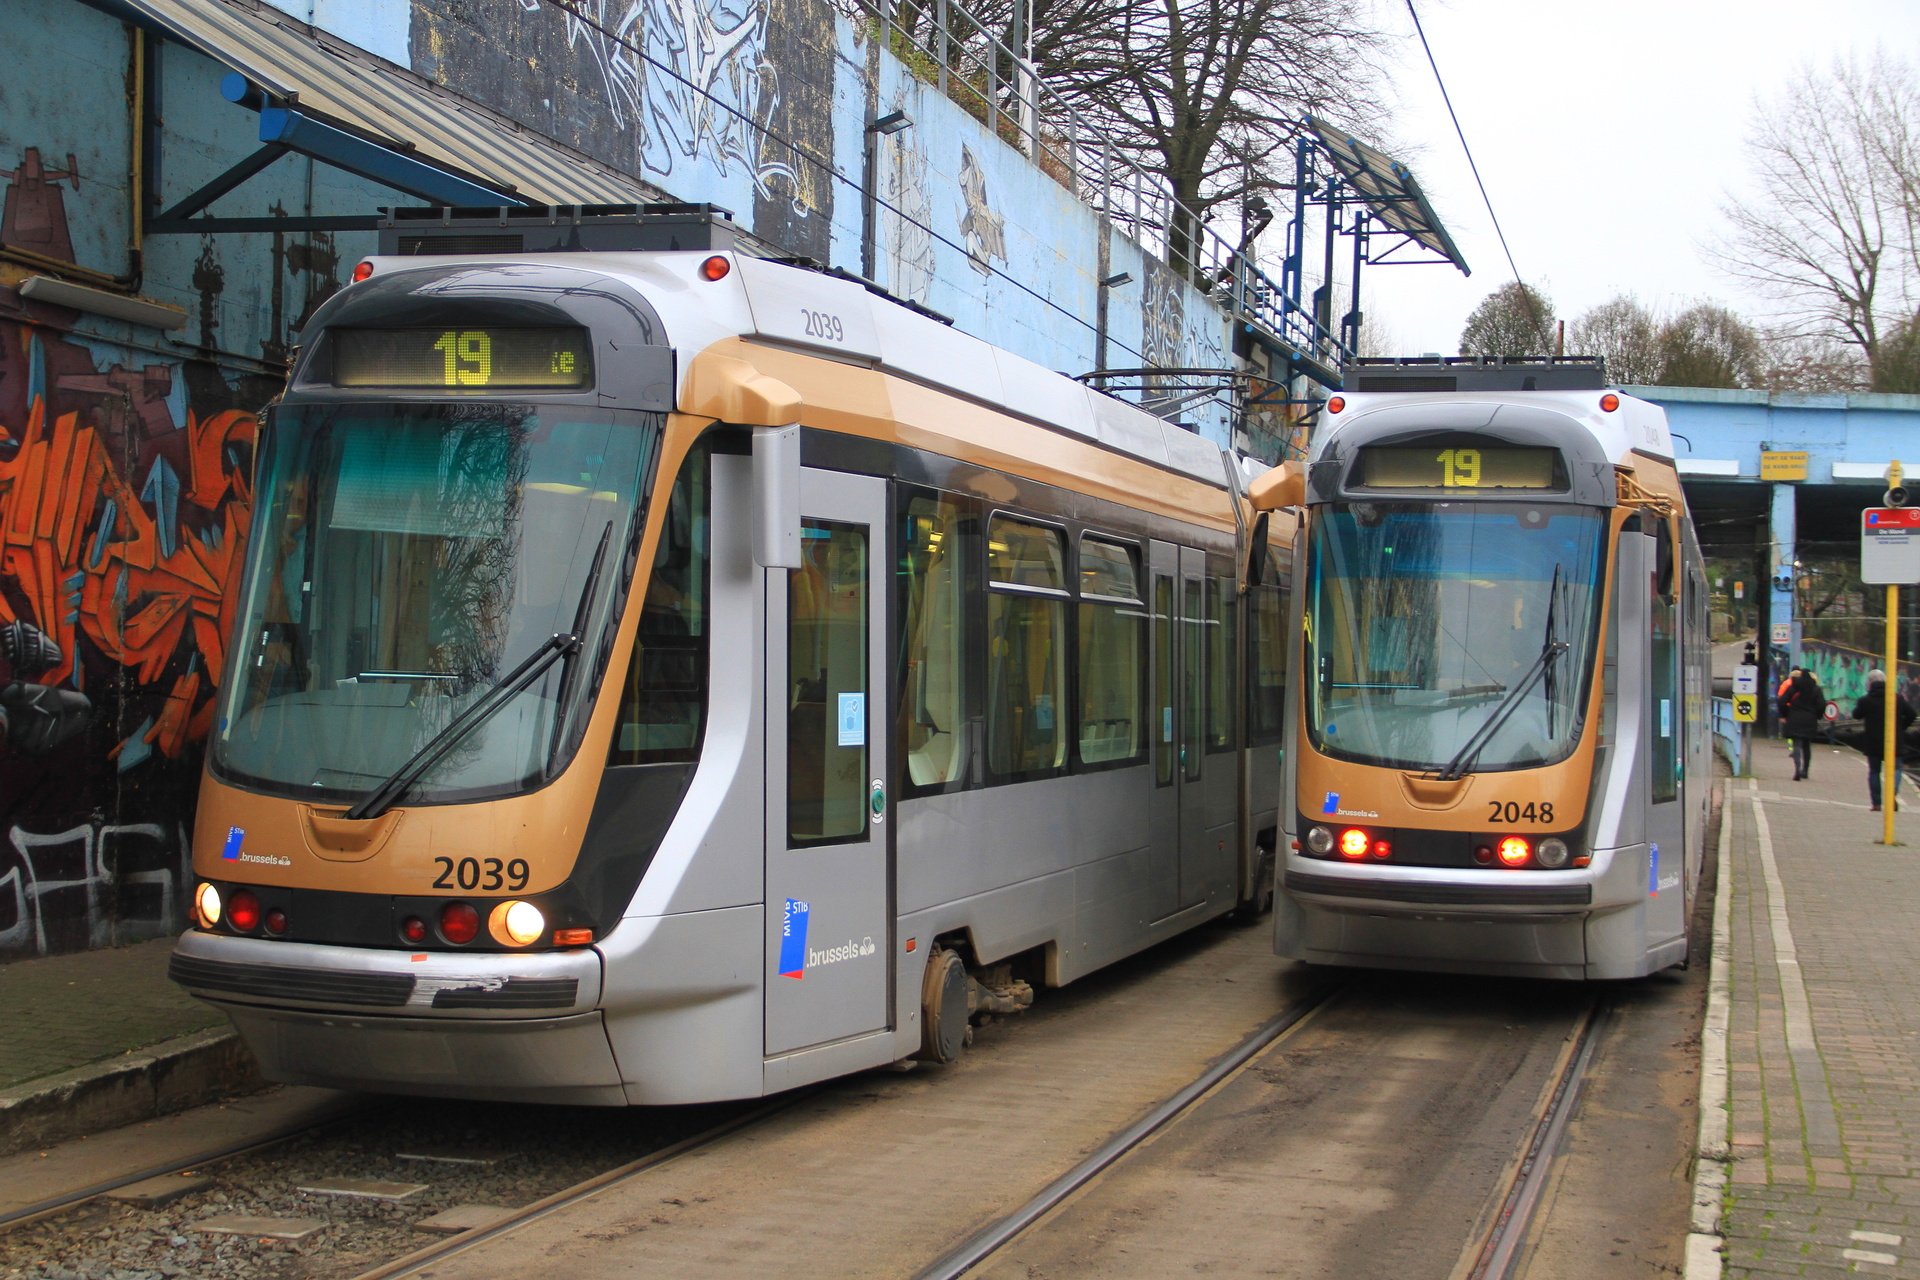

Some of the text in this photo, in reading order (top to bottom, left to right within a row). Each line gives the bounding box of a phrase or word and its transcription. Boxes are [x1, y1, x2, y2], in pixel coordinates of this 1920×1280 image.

[800, 308, 844, 343] 2039
[434, 331, 491, 385] 19
[1436, 449, 1481, 486] 19
[1487, 800, 1554, 824] 2048
[431, 856, 530, 892] 2039
